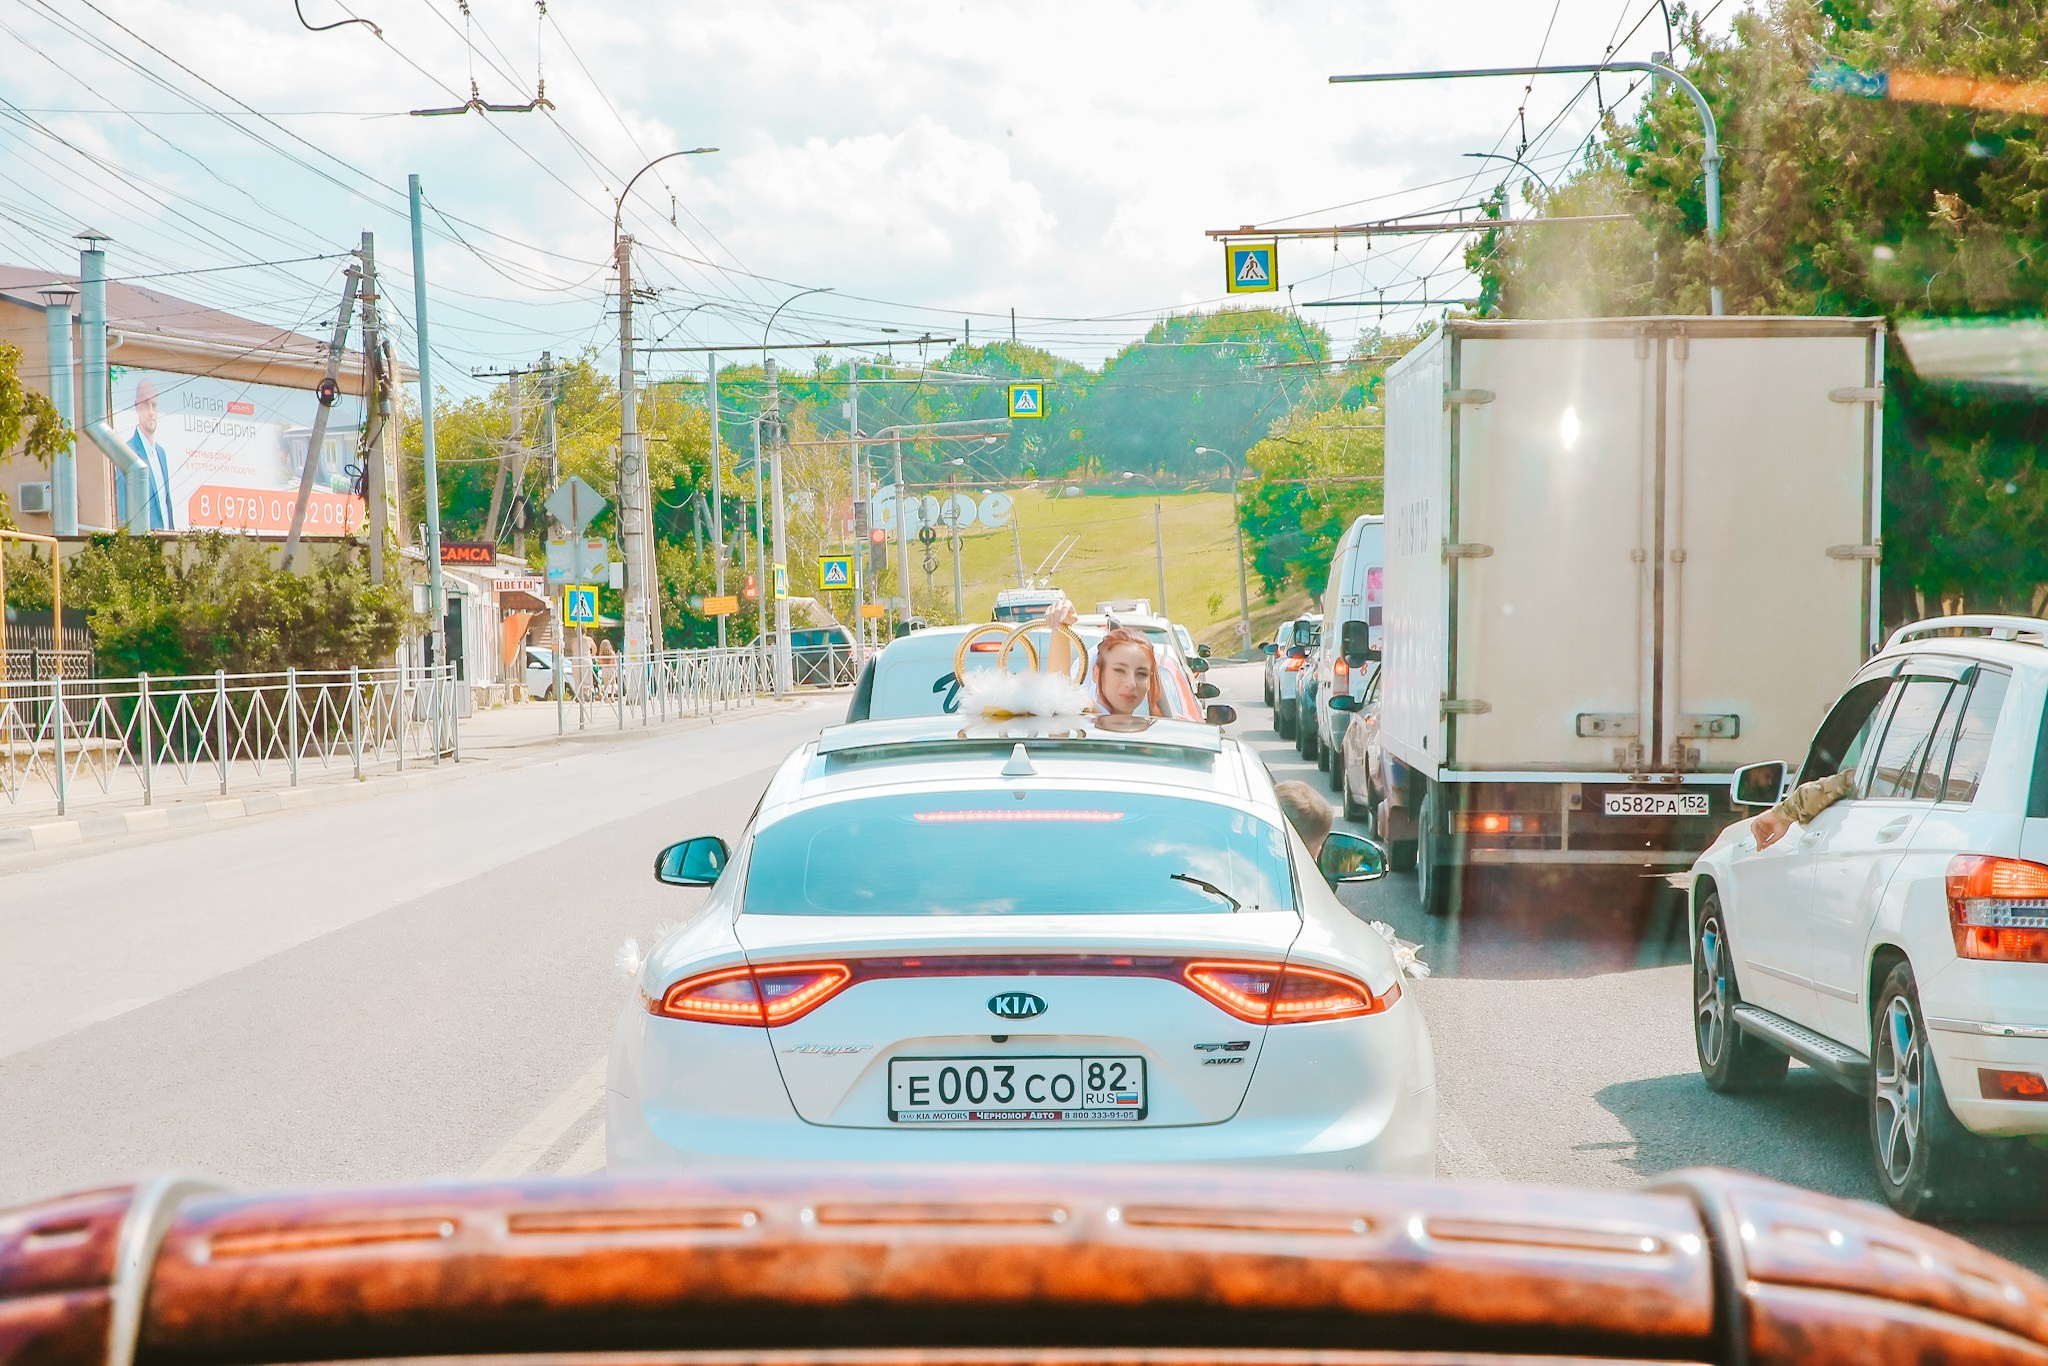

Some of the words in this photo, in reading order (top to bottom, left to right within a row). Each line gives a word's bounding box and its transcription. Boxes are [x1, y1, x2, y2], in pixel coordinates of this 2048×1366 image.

[183, 391, 224, 412] Малая
[184, 413, 256, 441] Швейцария
[200, 494, 211, 517] 8
[217, 492, 265, 524] (978)
[440, 547, 490, 561] САМСА
[496, 580, 533, 590] ЦВЕТЫ
[1680, 796, 1704, 808] 152
[996, 996, 1038, 1014] KIA
[1204, 1057, 1242, 1065] AWD
[1087, 1062, 1127, 1091] 82
[1086, 1093, 1115, 1104] RUS
[916, 1112, 930, 1120] KIA
[933, 1112, 968, 1120] MOTORS
[1064, 1111, 1071, 1119] 8
[1072, 1111, 1089, 1119] 800
[1091, 1111, 1134, 1119] 333-91-05
